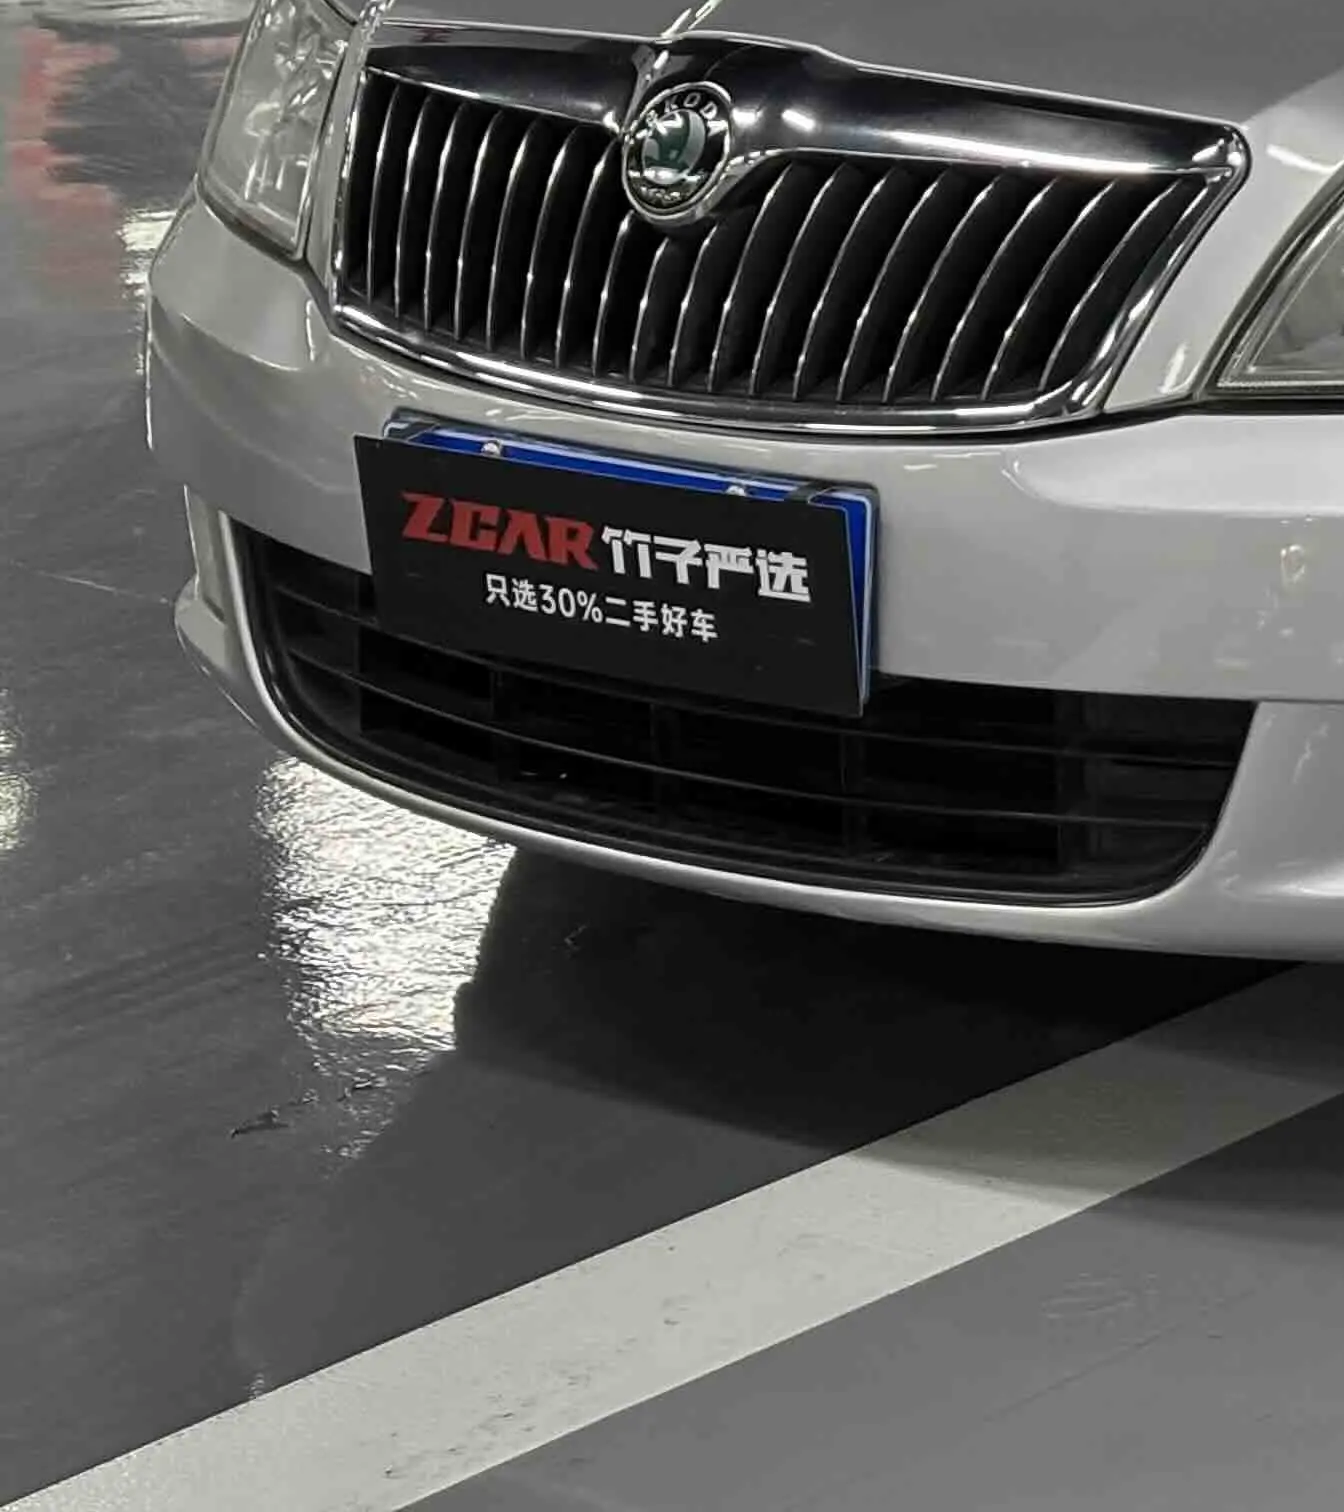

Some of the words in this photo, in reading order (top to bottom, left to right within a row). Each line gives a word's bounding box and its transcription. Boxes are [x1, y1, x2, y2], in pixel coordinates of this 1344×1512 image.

[401, 492, 598, 571] ZCAR
[601, 526, 811, 603] 竹子严选
[485, 572, 718, 642] 只选30%二手好车
